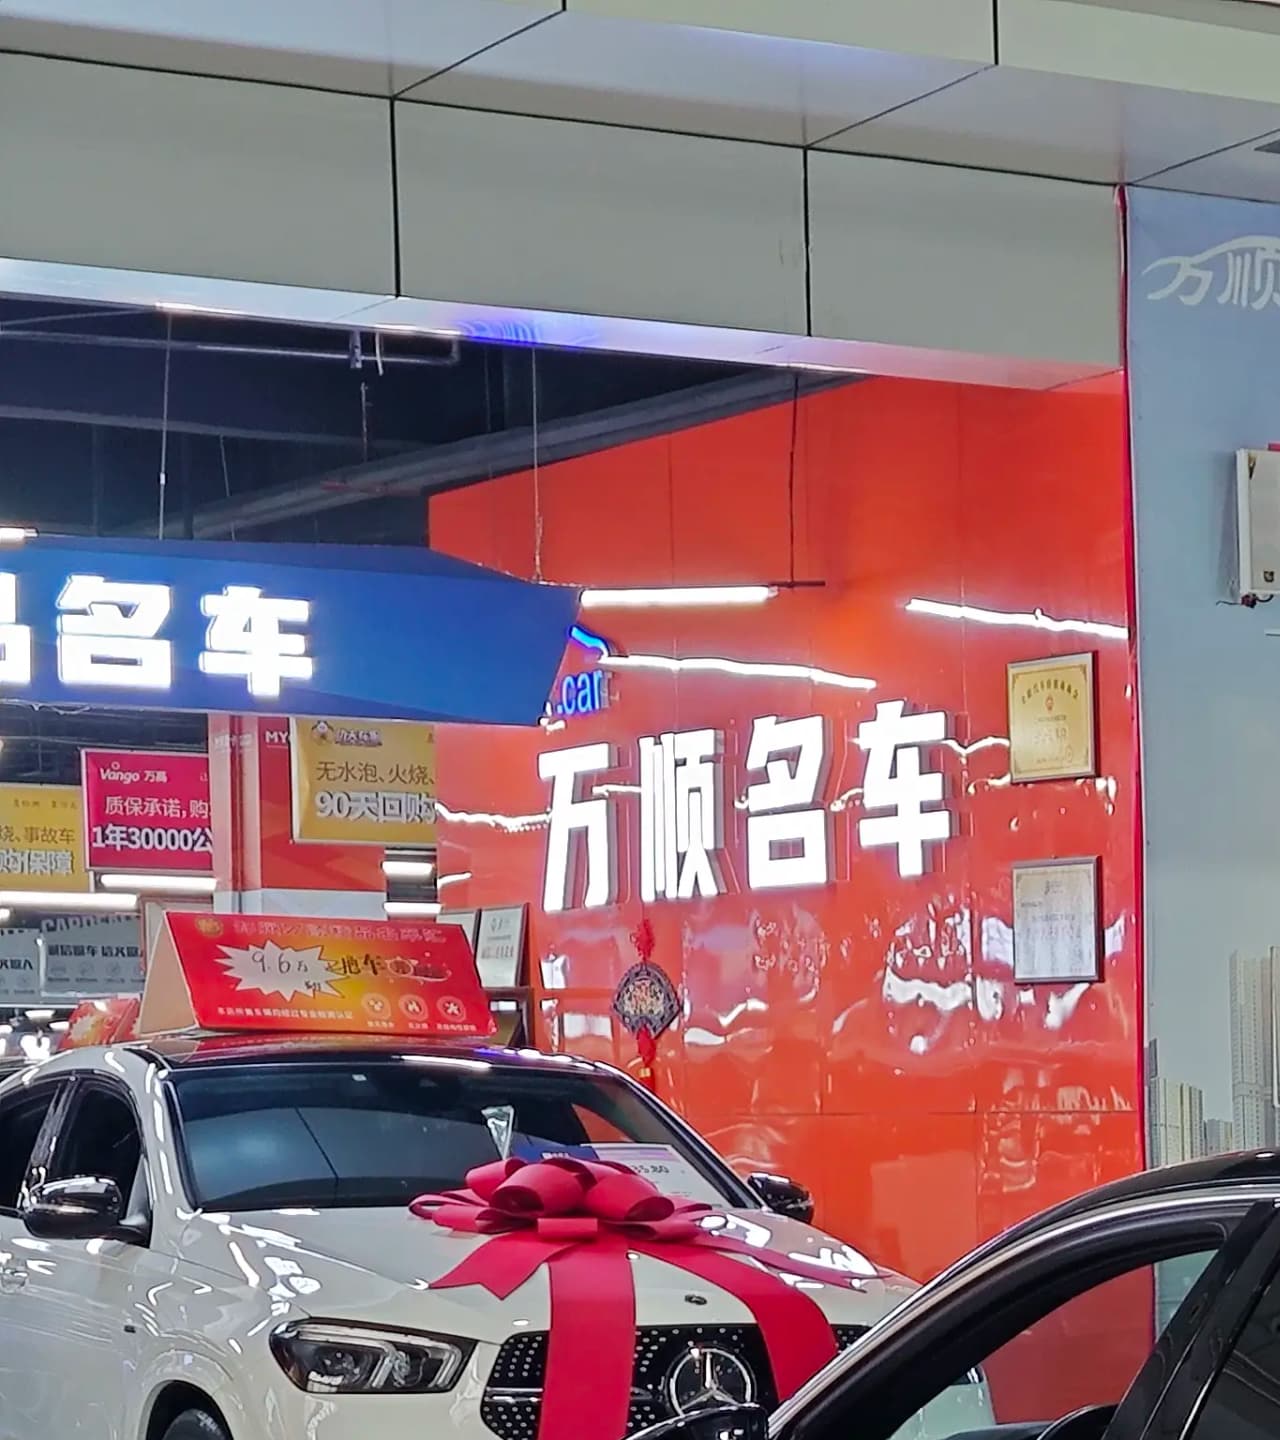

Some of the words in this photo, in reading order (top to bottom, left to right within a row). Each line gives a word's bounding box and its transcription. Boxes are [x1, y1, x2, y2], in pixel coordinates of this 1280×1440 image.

[0, 571, 314, 697] 名车
[265, 731, 290, 743] MY
[105, 796, 213, 818] 质保承诺,购
[316, 792, 436, 823] 90天回购
[538, 700, 951, 912] 万顺名车
